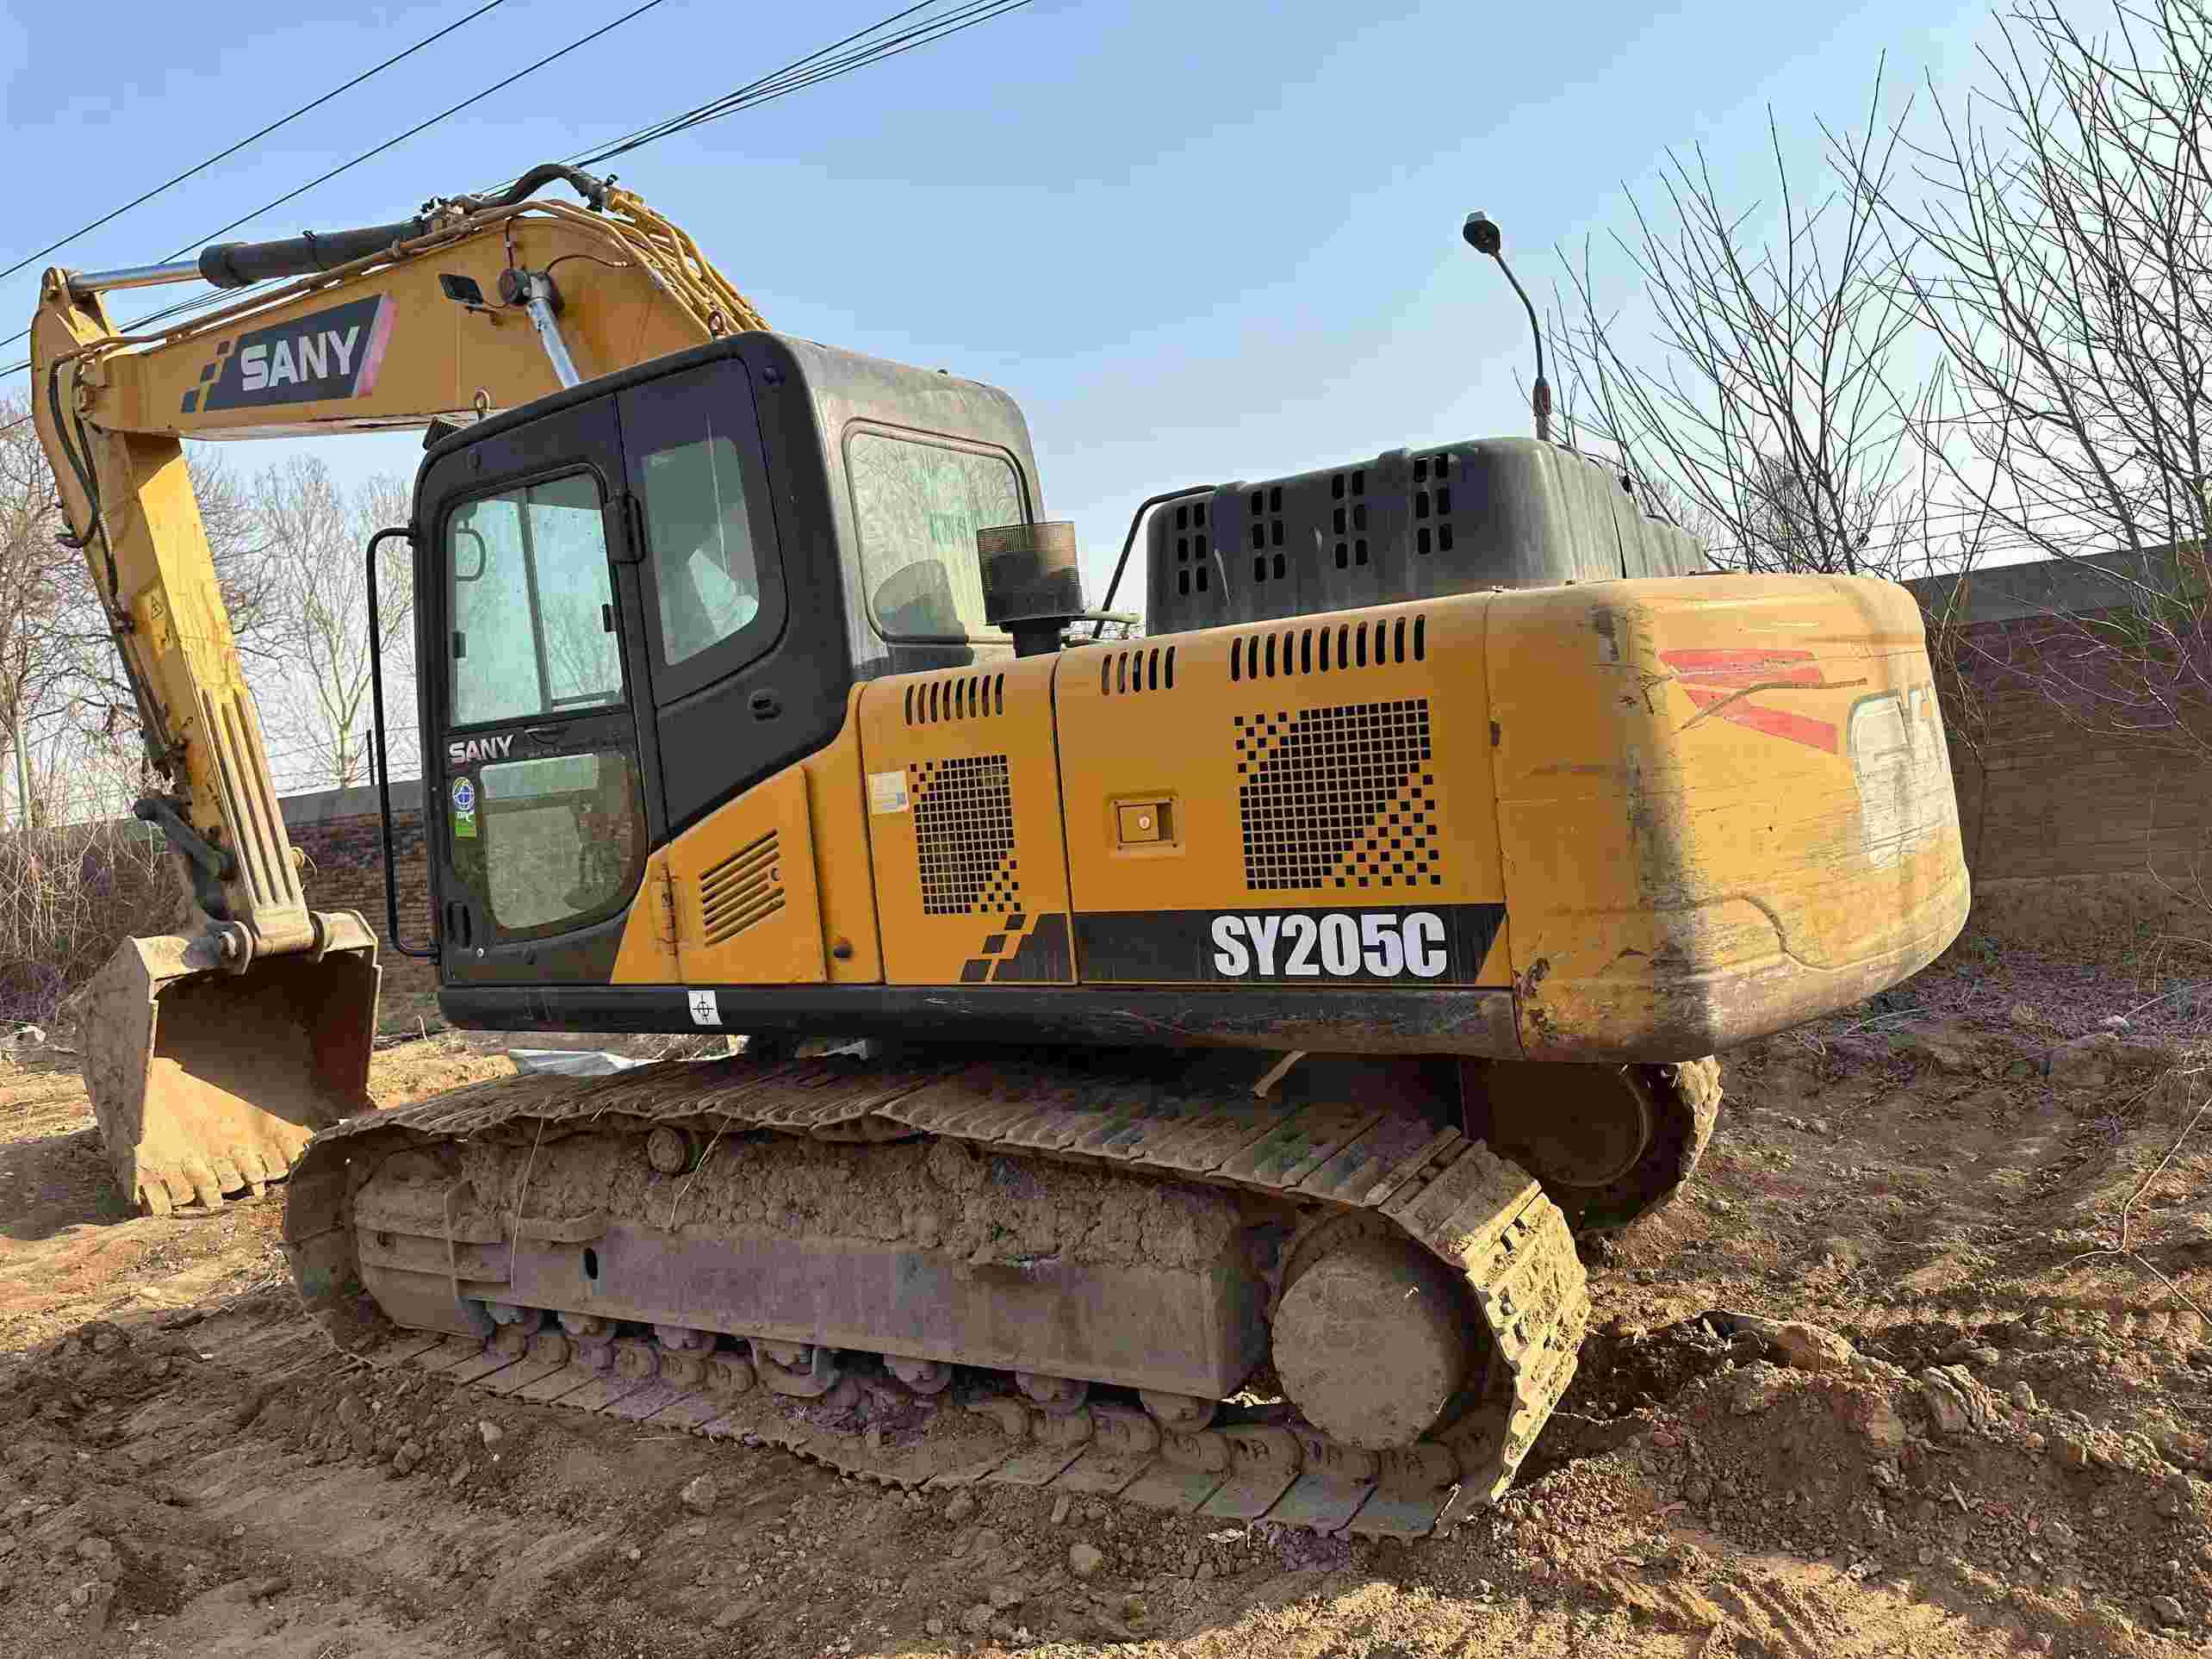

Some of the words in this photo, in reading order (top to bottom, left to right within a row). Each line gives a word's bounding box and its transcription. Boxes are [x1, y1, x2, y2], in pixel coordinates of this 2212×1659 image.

[240, 326, 360, 392] SANY
[449, 734, 514, 764] SANY
[1211, 911, 1447, 978] SY205C
